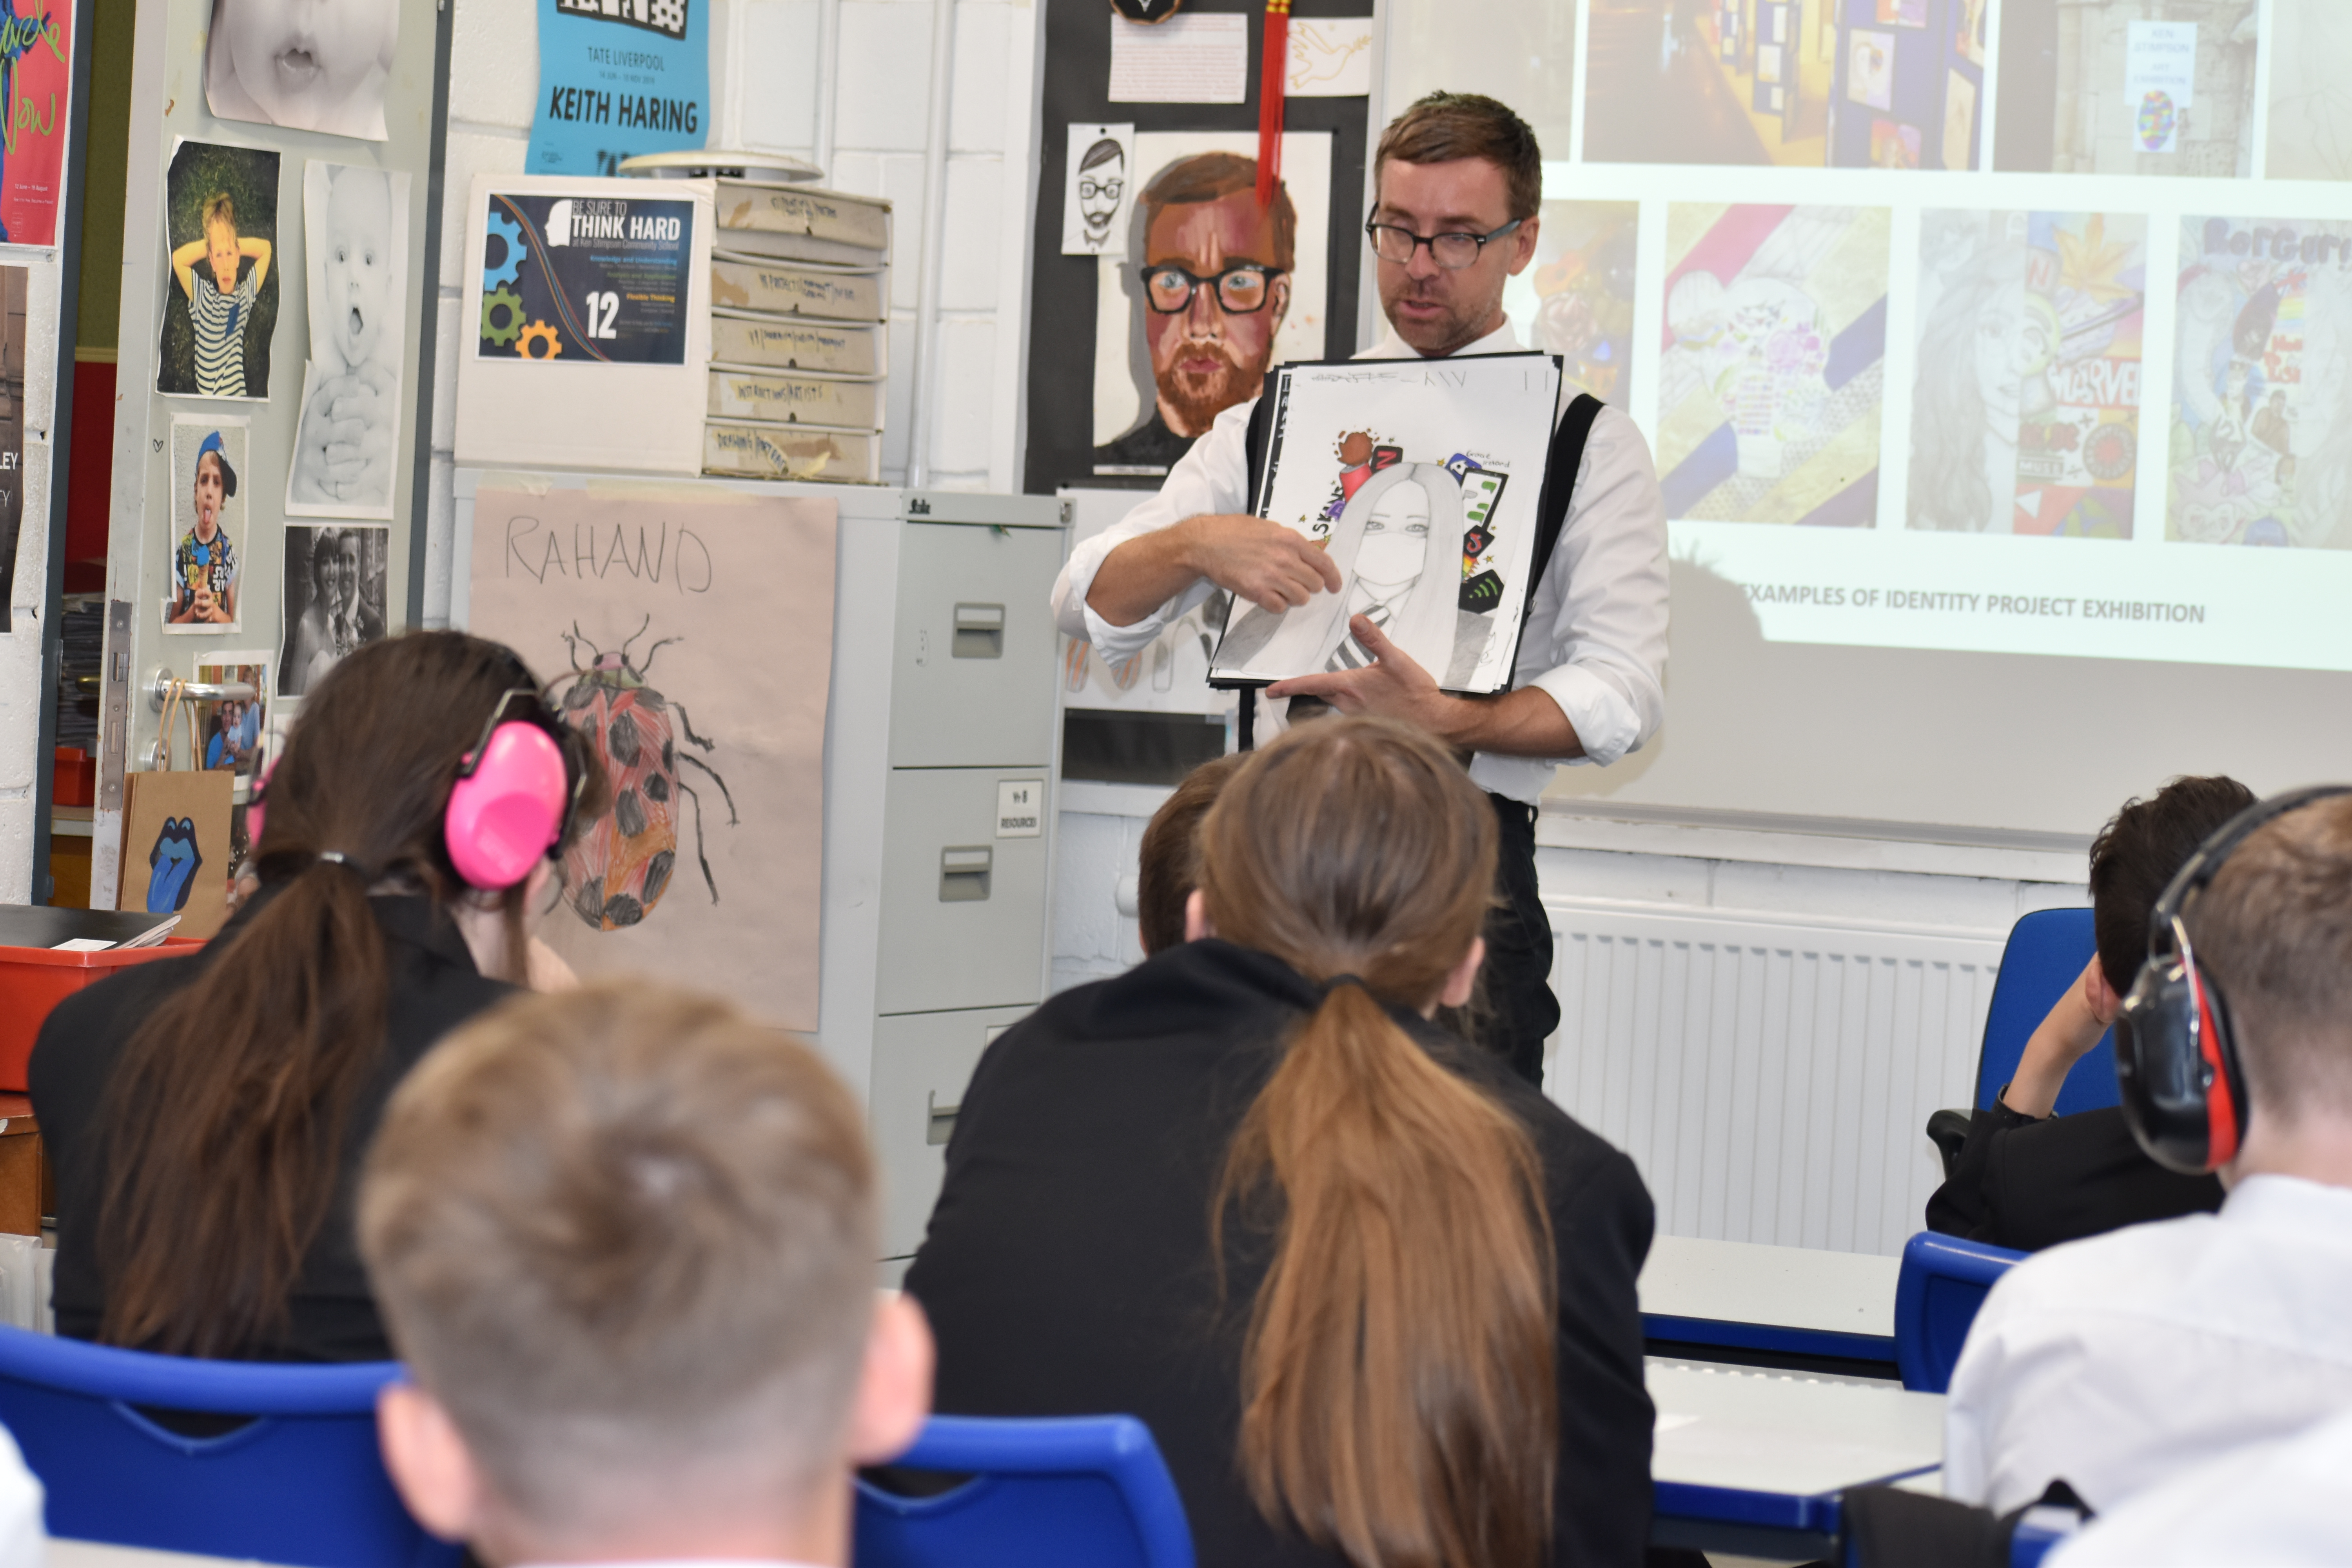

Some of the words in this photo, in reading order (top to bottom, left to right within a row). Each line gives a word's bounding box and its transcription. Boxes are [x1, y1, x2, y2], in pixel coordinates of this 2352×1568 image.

[588, 47, 610, 65] TATE
[613, 50, 664, 71] LIVERPOOL
[550, 85, 611, 125] KEITH
[618, 94, 697, 134] HARING
[573, 200, 583, 215] BE
[586, 200, 612, 216] SURE
[615, 201, 627, 216] TO
[572, 215, 625, 239] THINK
[630, 216, 681, 241] HARD
[580, 239, 592, 248] Ken
[593, 239, 622, 250] Stimpson
[622, 240, 657, 252] Community
[658, 241, 679, 250] School
[586, 291, 619, 339] 12
[1851, 589, 1880, 608] OF
[1886, 590, 1980, 612] IDENTITY
[1987, 594, 2076, 617] PROJECT
[2083, 599, 2205, 624] EXHIBITION
[1001, 817, 1037, 829] RESOURCES
